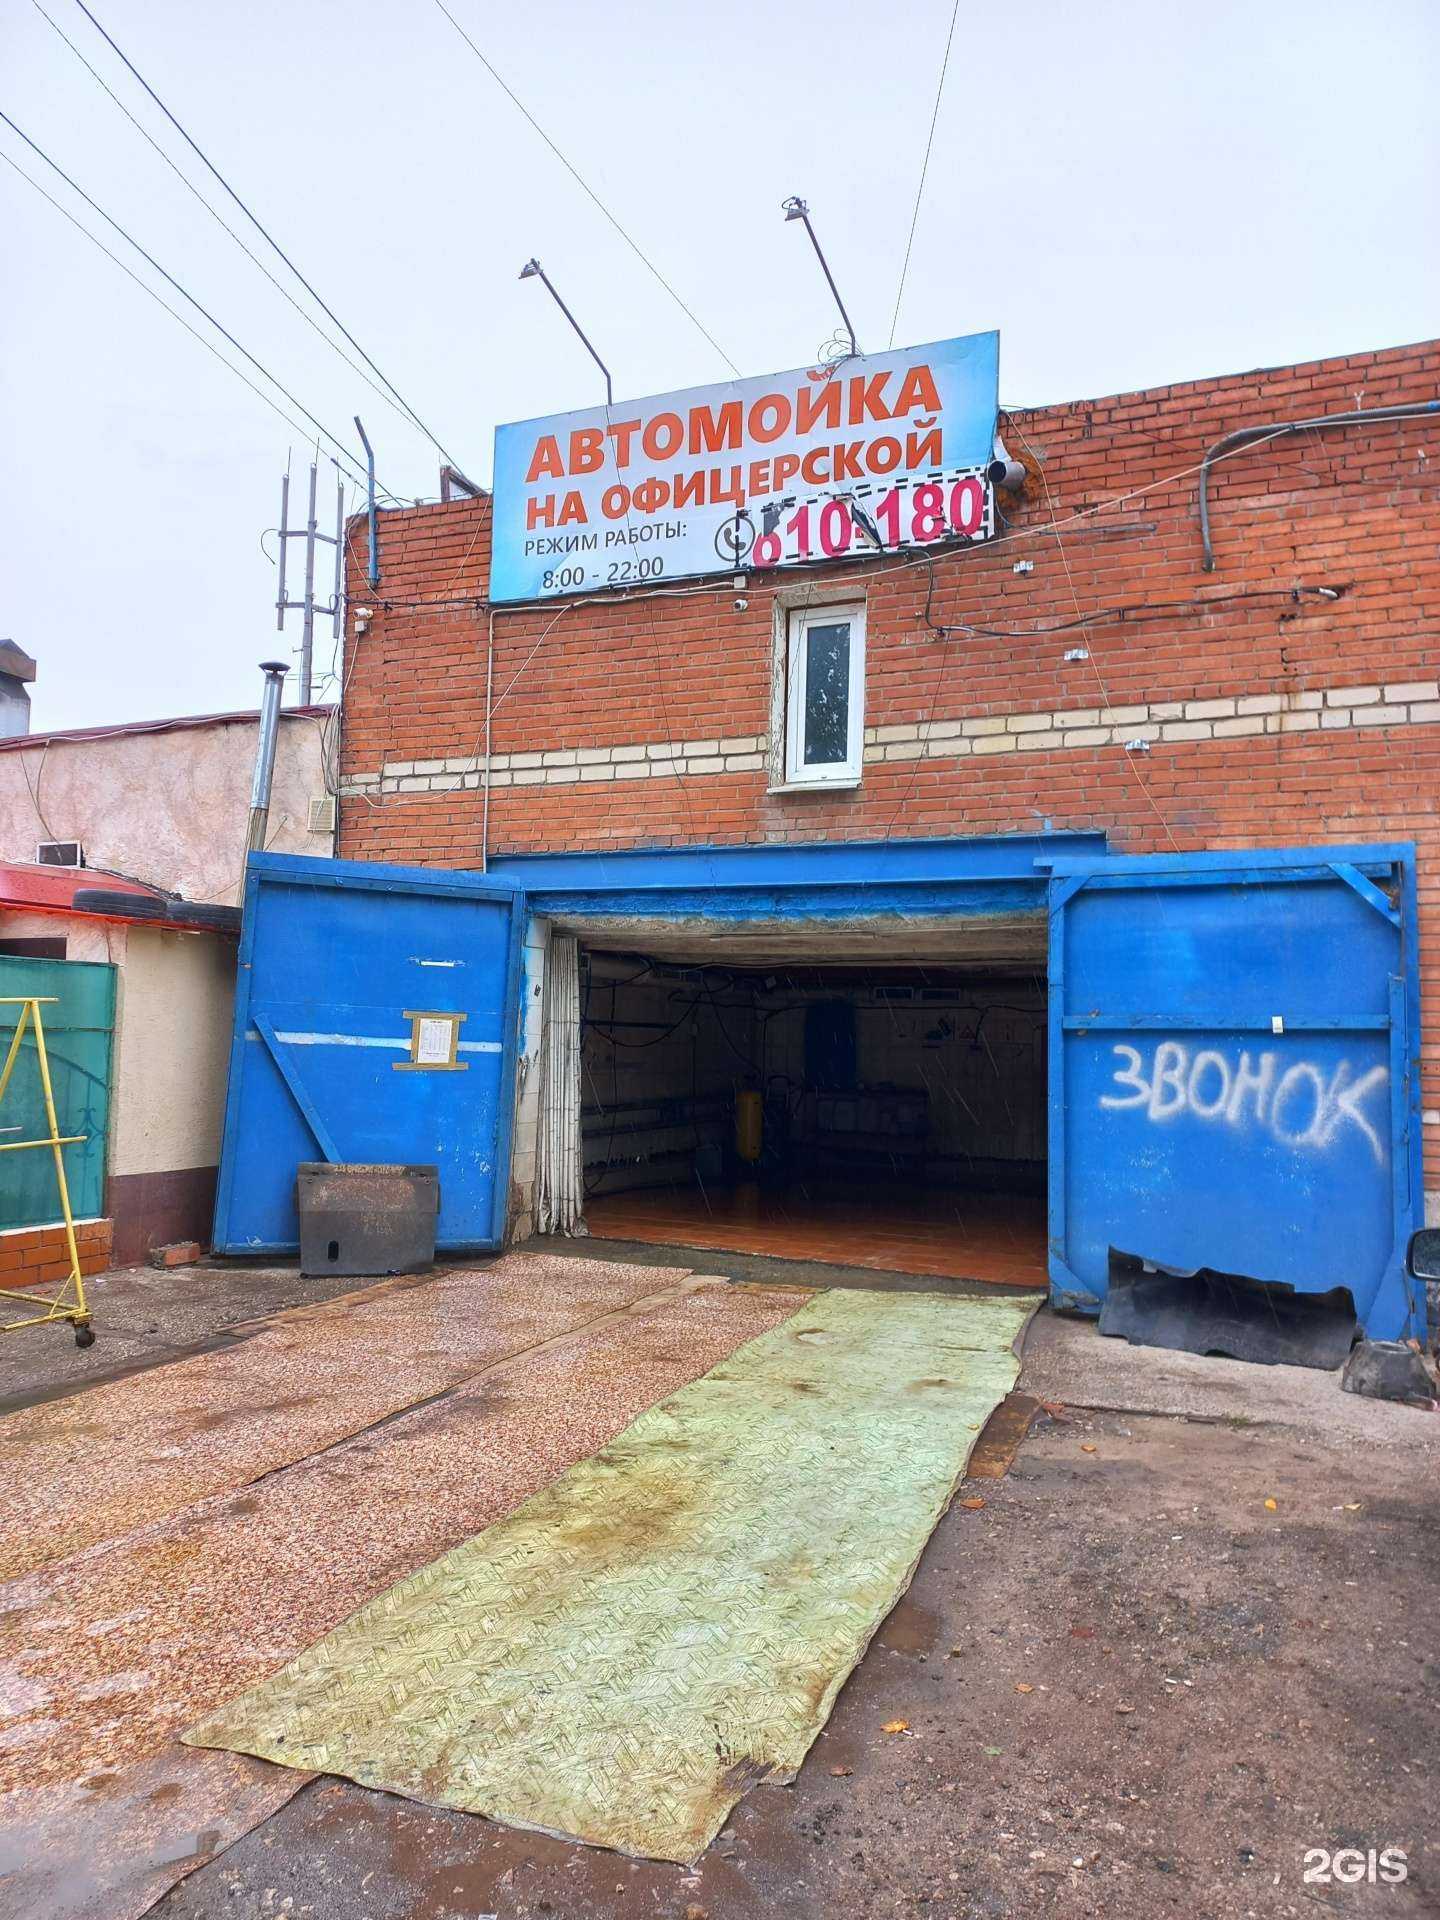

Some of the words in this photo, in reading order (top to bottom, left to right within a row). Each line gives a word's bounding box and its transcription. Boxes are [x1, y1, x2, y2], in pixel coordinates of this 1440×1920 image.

[525, 365, 943, 483] АВТОМОЙКА
[526, 490, 588, 530] НА
[601, 416, 942, 520] ОФИЦЕРСКОЙ
[525, 533, 598, 556] РЕЖИМ
[605, 521, 687, 548] РАБОТЫ:
[542, 566, 584, 590] 8:00
[607, 556, 664, 582] 22:00
[1100, 1041, 1388, 1164] ЗВОНОК
